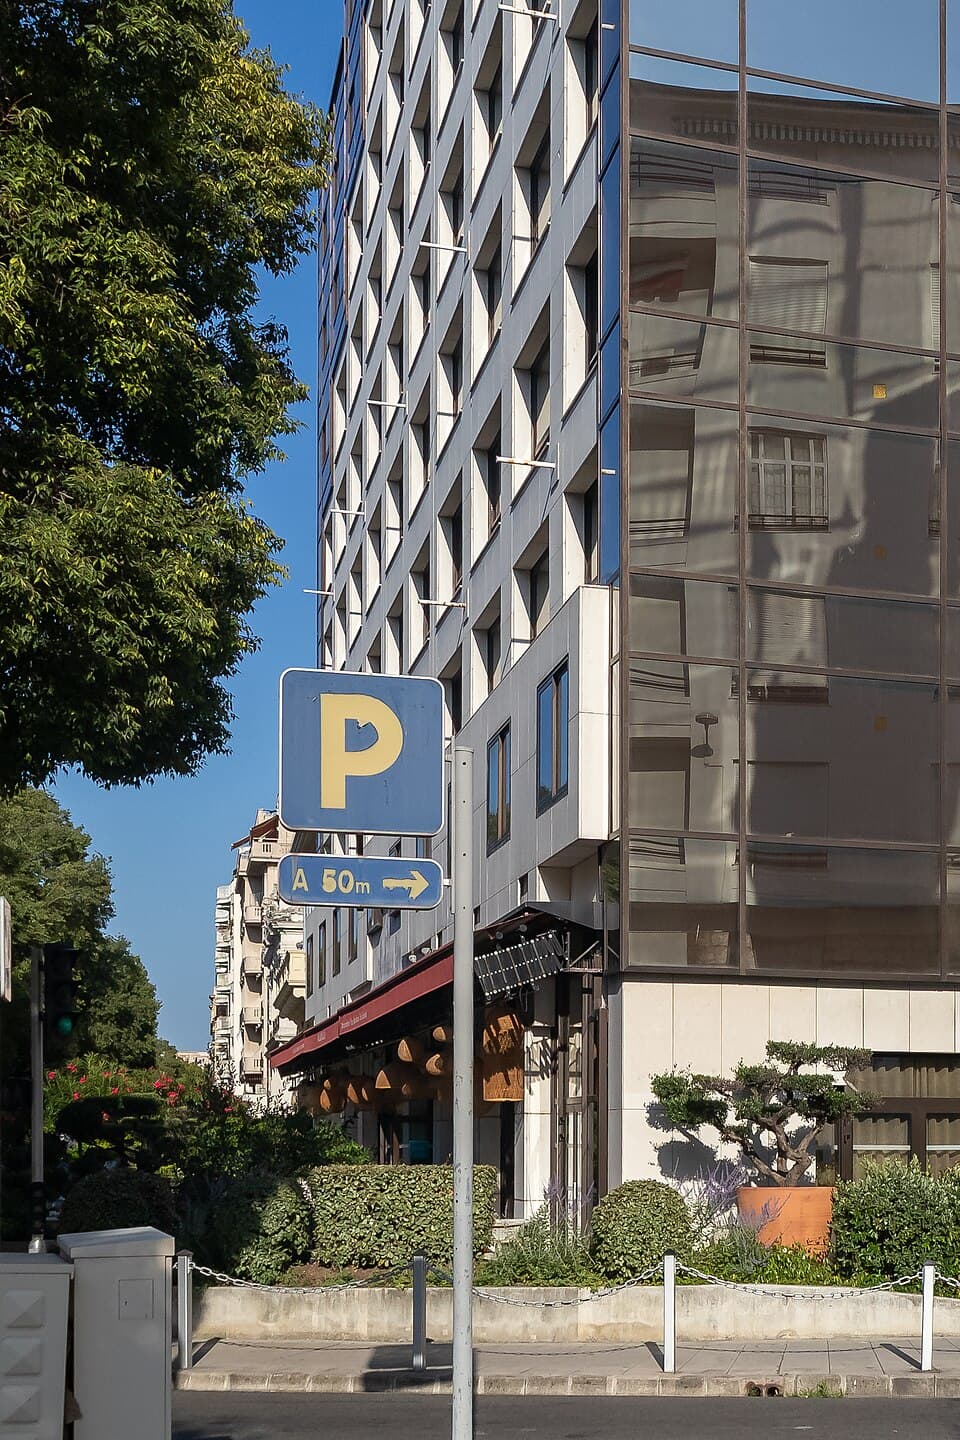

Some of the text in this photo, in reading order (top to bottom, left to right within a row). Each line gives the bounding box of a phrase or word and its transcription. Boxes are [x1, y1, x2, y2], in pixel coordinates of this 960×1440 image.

[320, 693, 404, 809] P
[292, 868, 371, 894] A 50m
